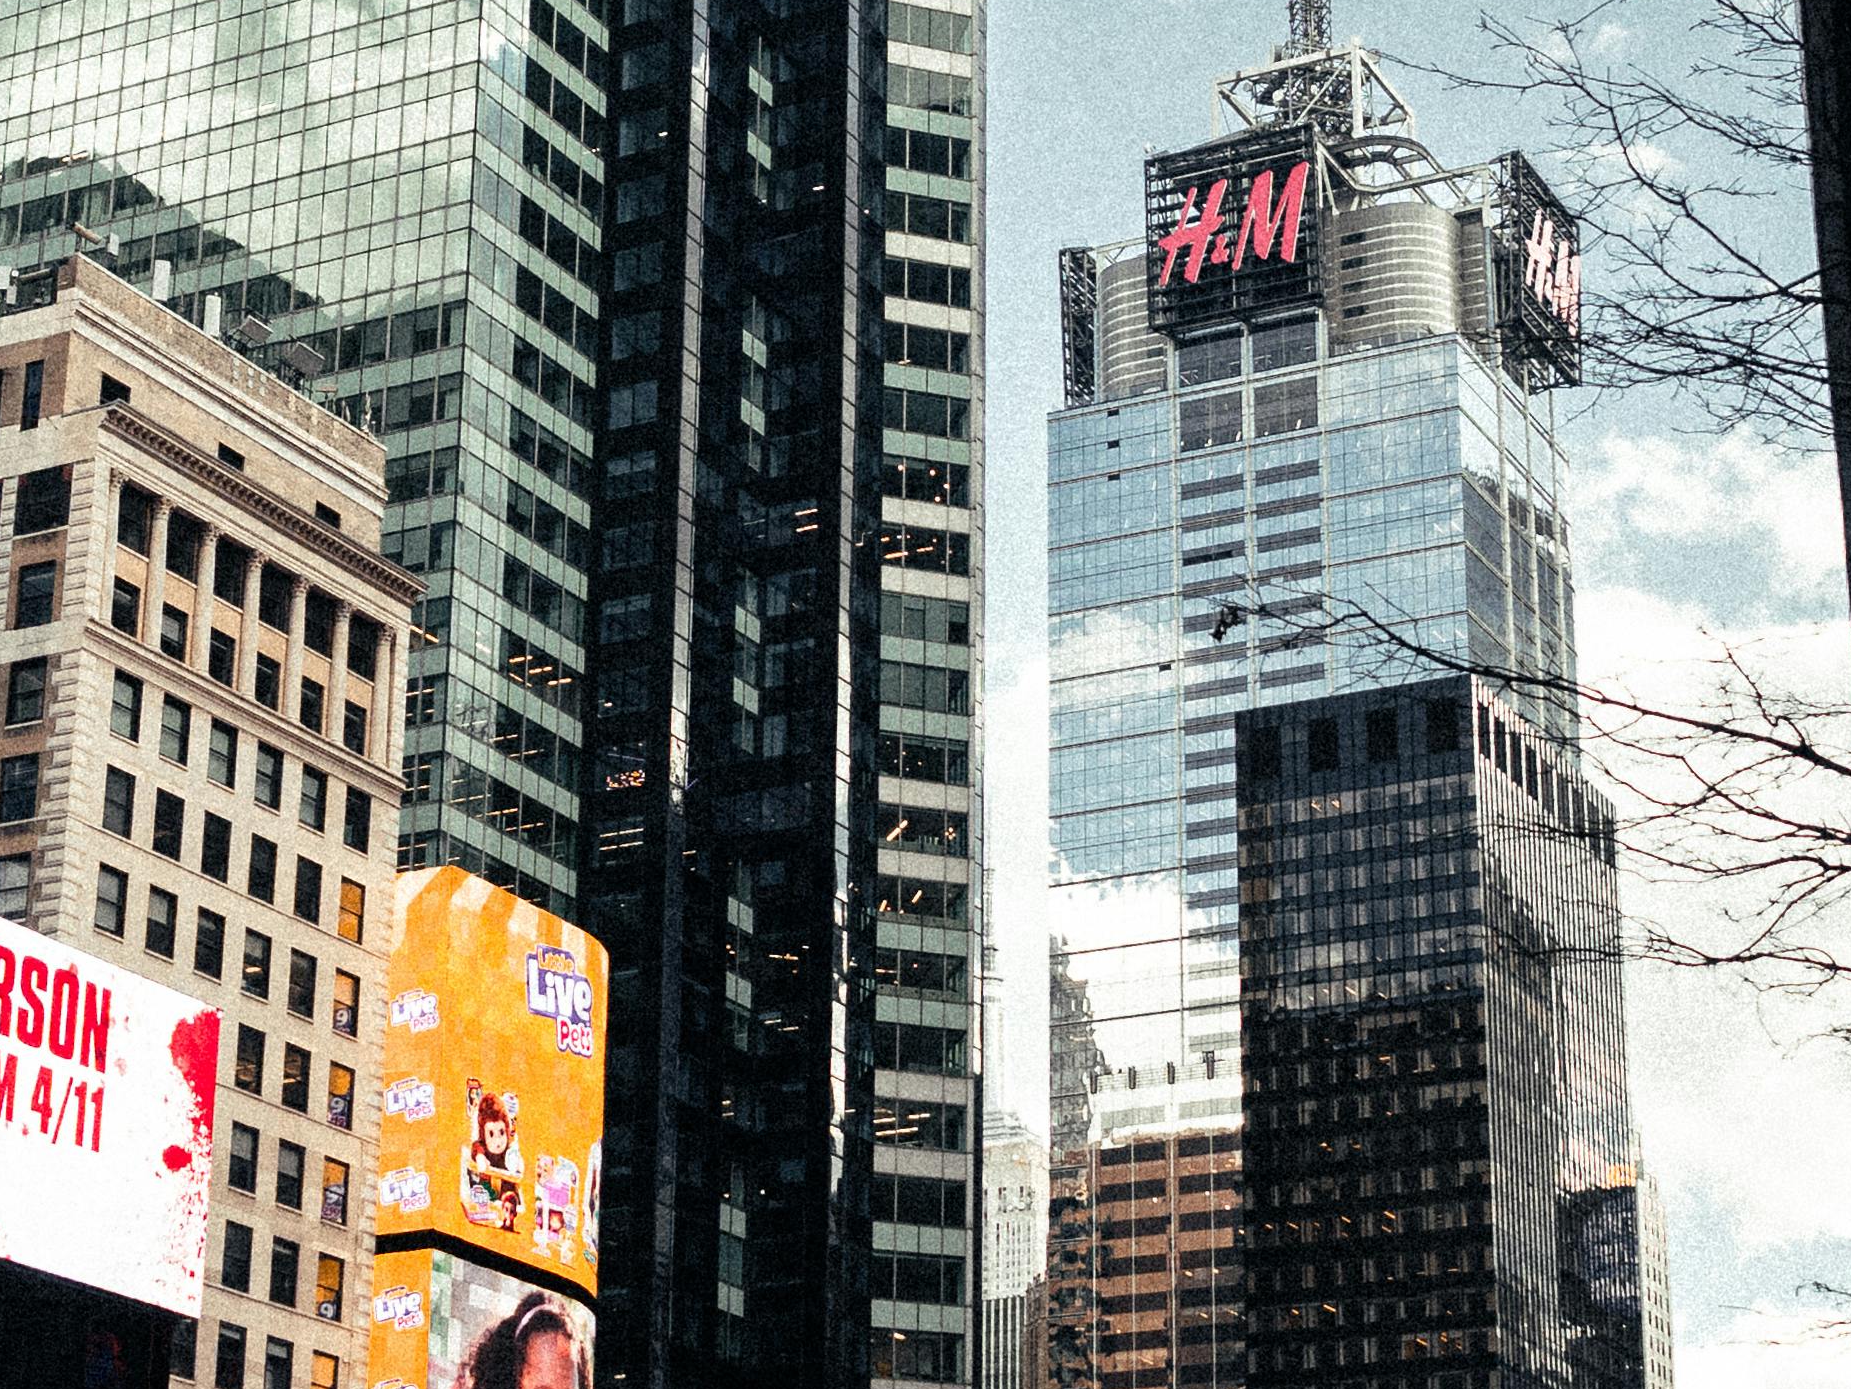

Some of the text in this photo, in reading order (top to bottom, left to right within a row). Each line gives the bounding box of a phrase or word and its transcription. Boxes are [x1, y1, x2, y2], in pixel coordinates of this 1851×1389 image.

[1158, 161, 1310, 288] H&M
[529, 959, 592, 1021] Live
[560, 1019, 593, 1057] Pets
[29, 1067, 104, 1153] 4/11
[375, 1292, 422, 1322] Live
